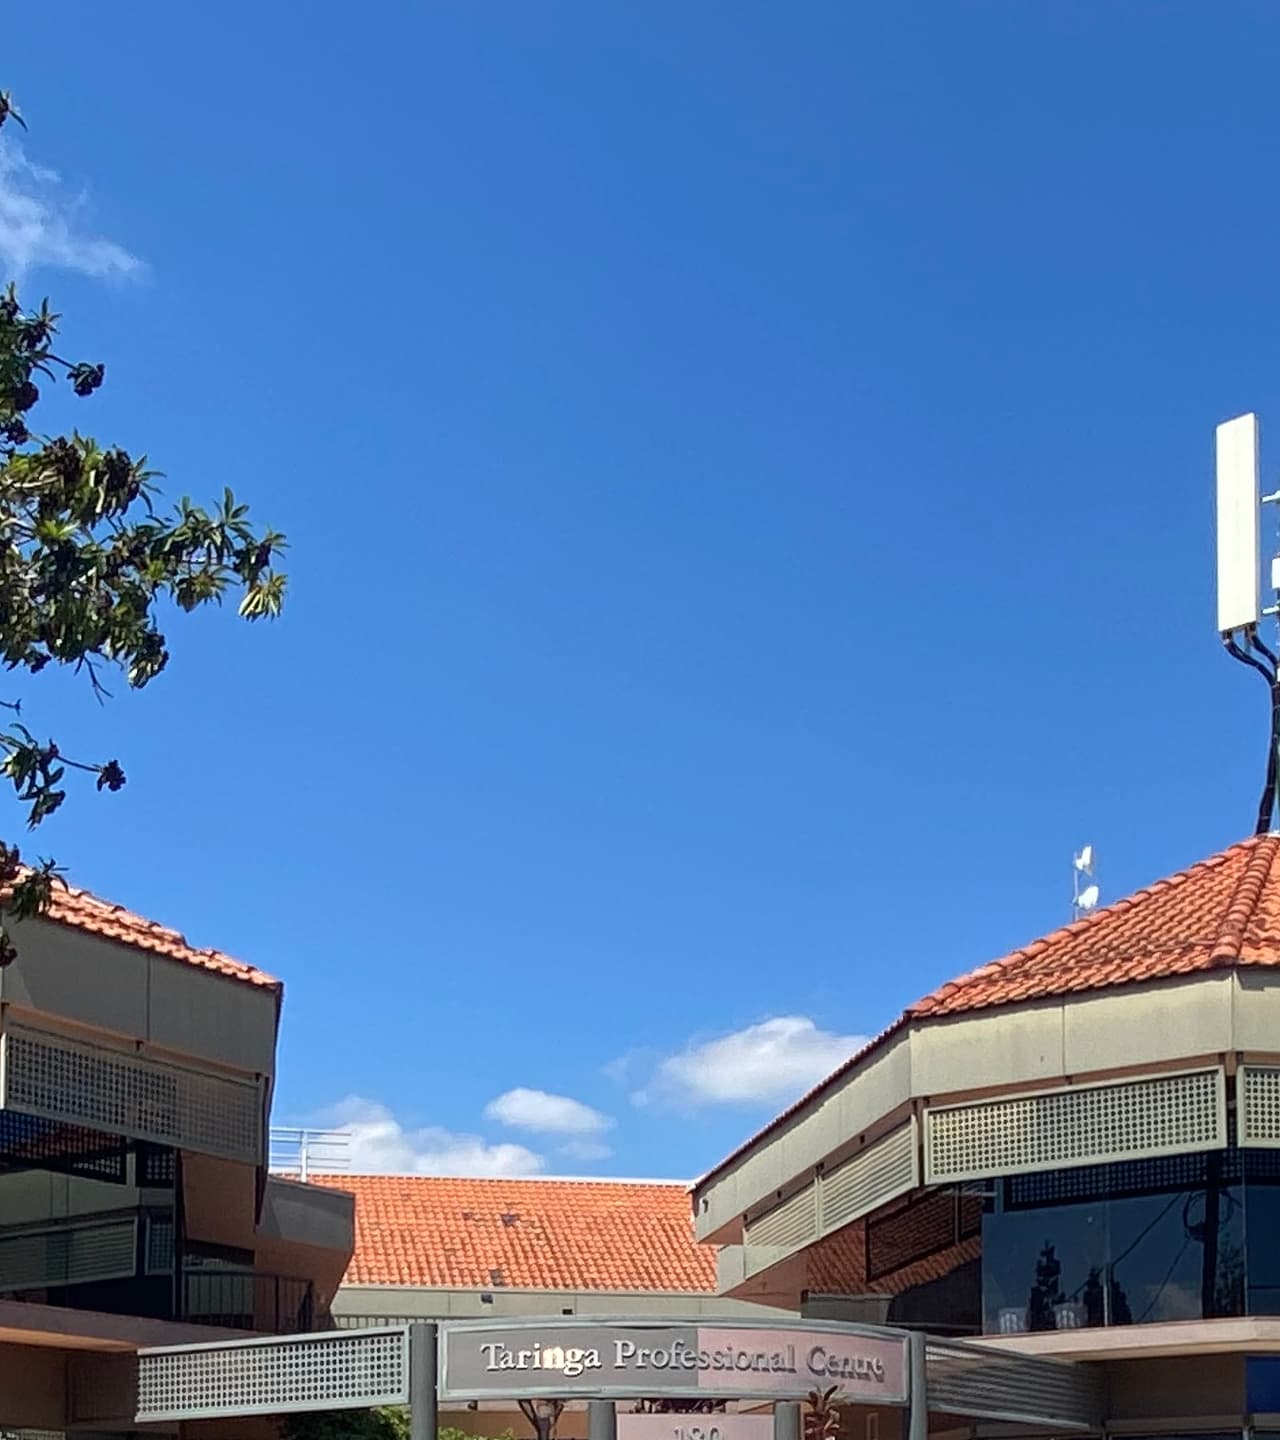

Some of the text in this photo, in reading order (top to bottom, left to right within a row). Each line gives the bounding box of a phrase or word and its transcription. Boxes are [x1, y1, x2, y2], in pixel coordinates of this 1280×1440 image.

[480, 1338, 886, 1383] Taringa Professional Centre
